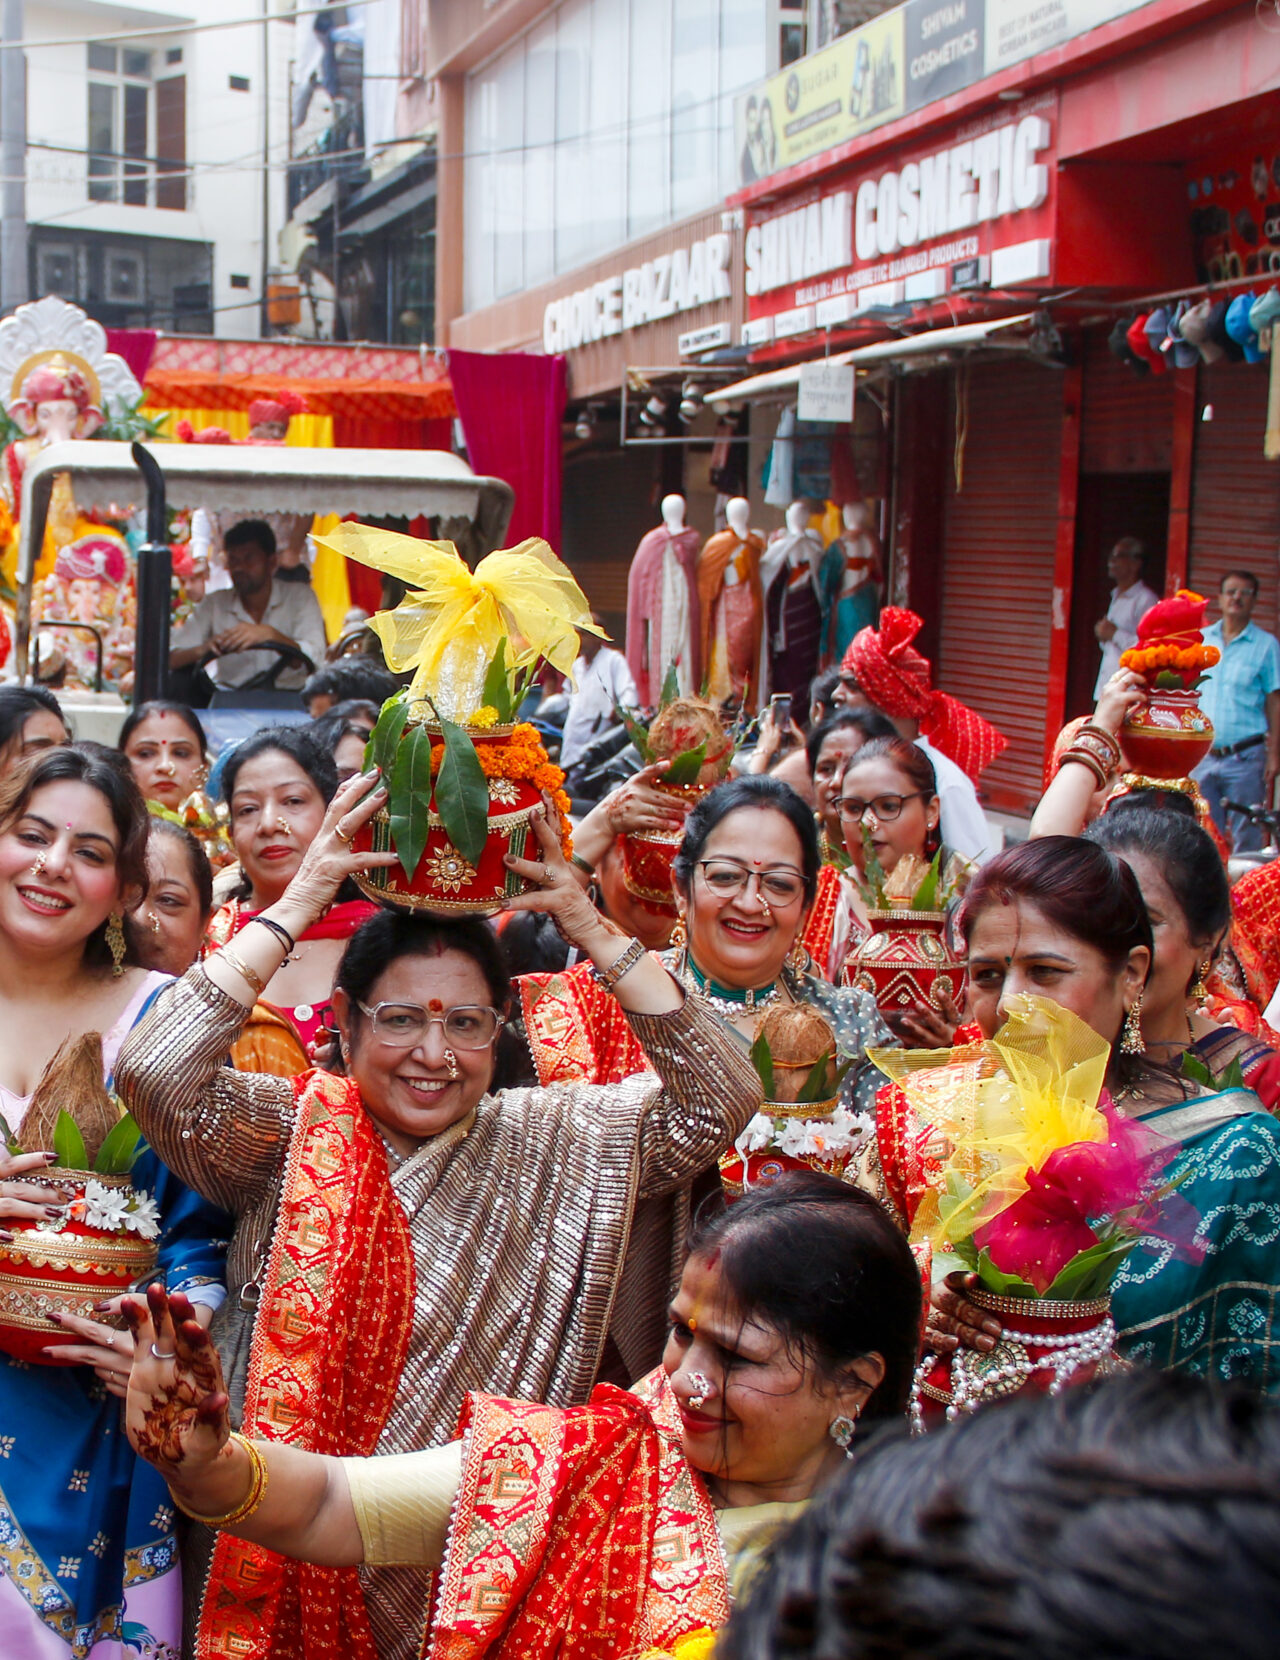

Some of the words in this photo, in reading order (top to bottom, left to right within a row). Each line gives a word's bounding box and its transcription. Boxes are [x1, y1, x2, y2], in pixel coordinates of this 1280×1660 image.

[921, 0, 966, 40] SHIVAM
[910, 28, 978, 80] COSMETICS
[745, 190, 853, 296] SHIVAM
[855, 115, 1050, 261] COSMETIC
[847, 263, 888, 291] COSMETIC
[888, 251, 927, 281] BRANDED
[929, 236, 979, 267] PRODUCTS
[543, 275, 622, 355] CHOICE
[623, 232, 732, 331] BAZAAR
